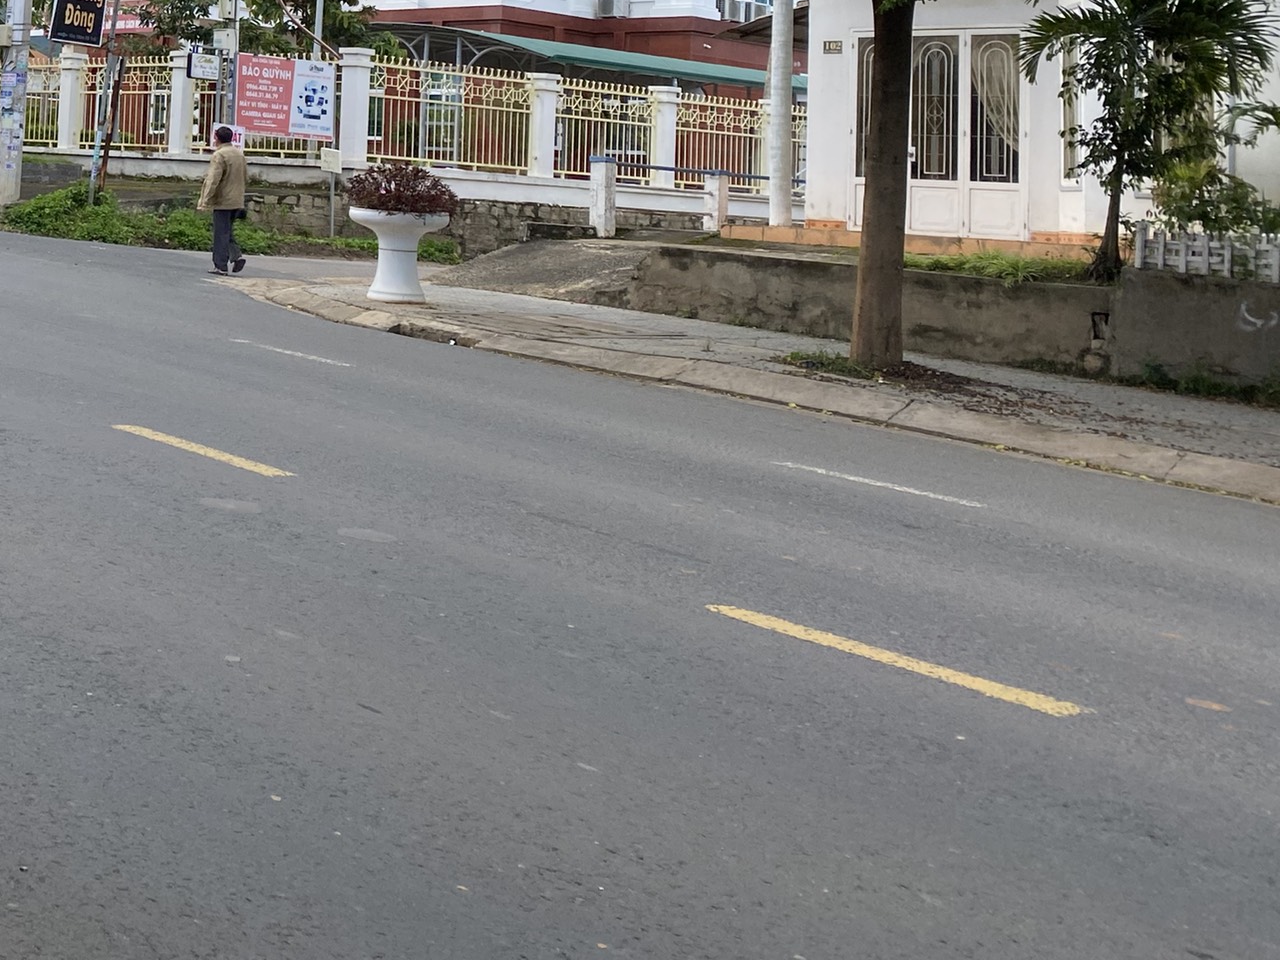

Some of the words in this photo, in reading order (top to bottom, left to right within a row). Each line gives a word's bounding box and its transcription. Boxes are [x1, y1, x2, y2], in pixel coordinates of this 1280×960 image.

[64, 3, 96, 34] Đông
[825, 42, 841, 50] 102
[241, 62, 260, 76] BẢO
[262, 66, 292, 80] QUỲNH
